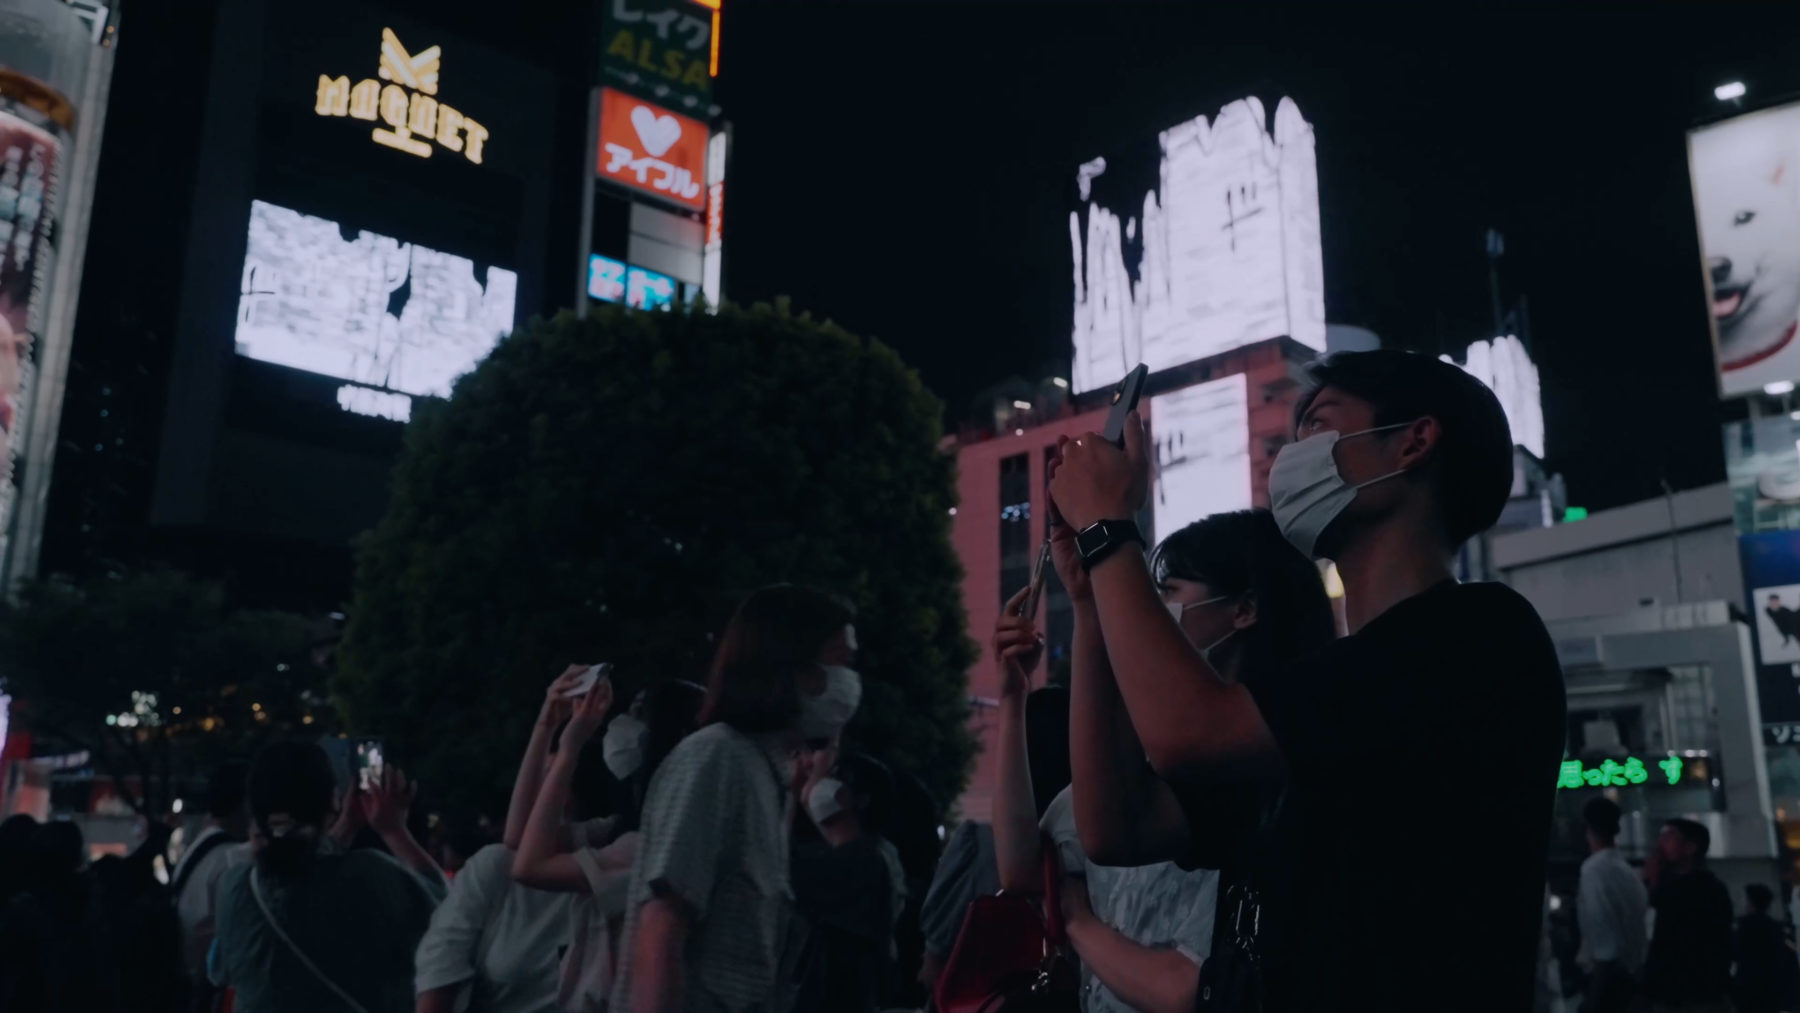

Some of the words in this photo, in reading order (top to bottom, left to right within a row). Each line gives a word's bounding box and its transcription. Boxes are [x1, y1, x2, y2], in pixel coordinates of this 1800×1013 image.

[613, 0, 709, 50] レイク
[607, 28, 709, 92] ALSA
[605, 142, 700, 199] アイフル
